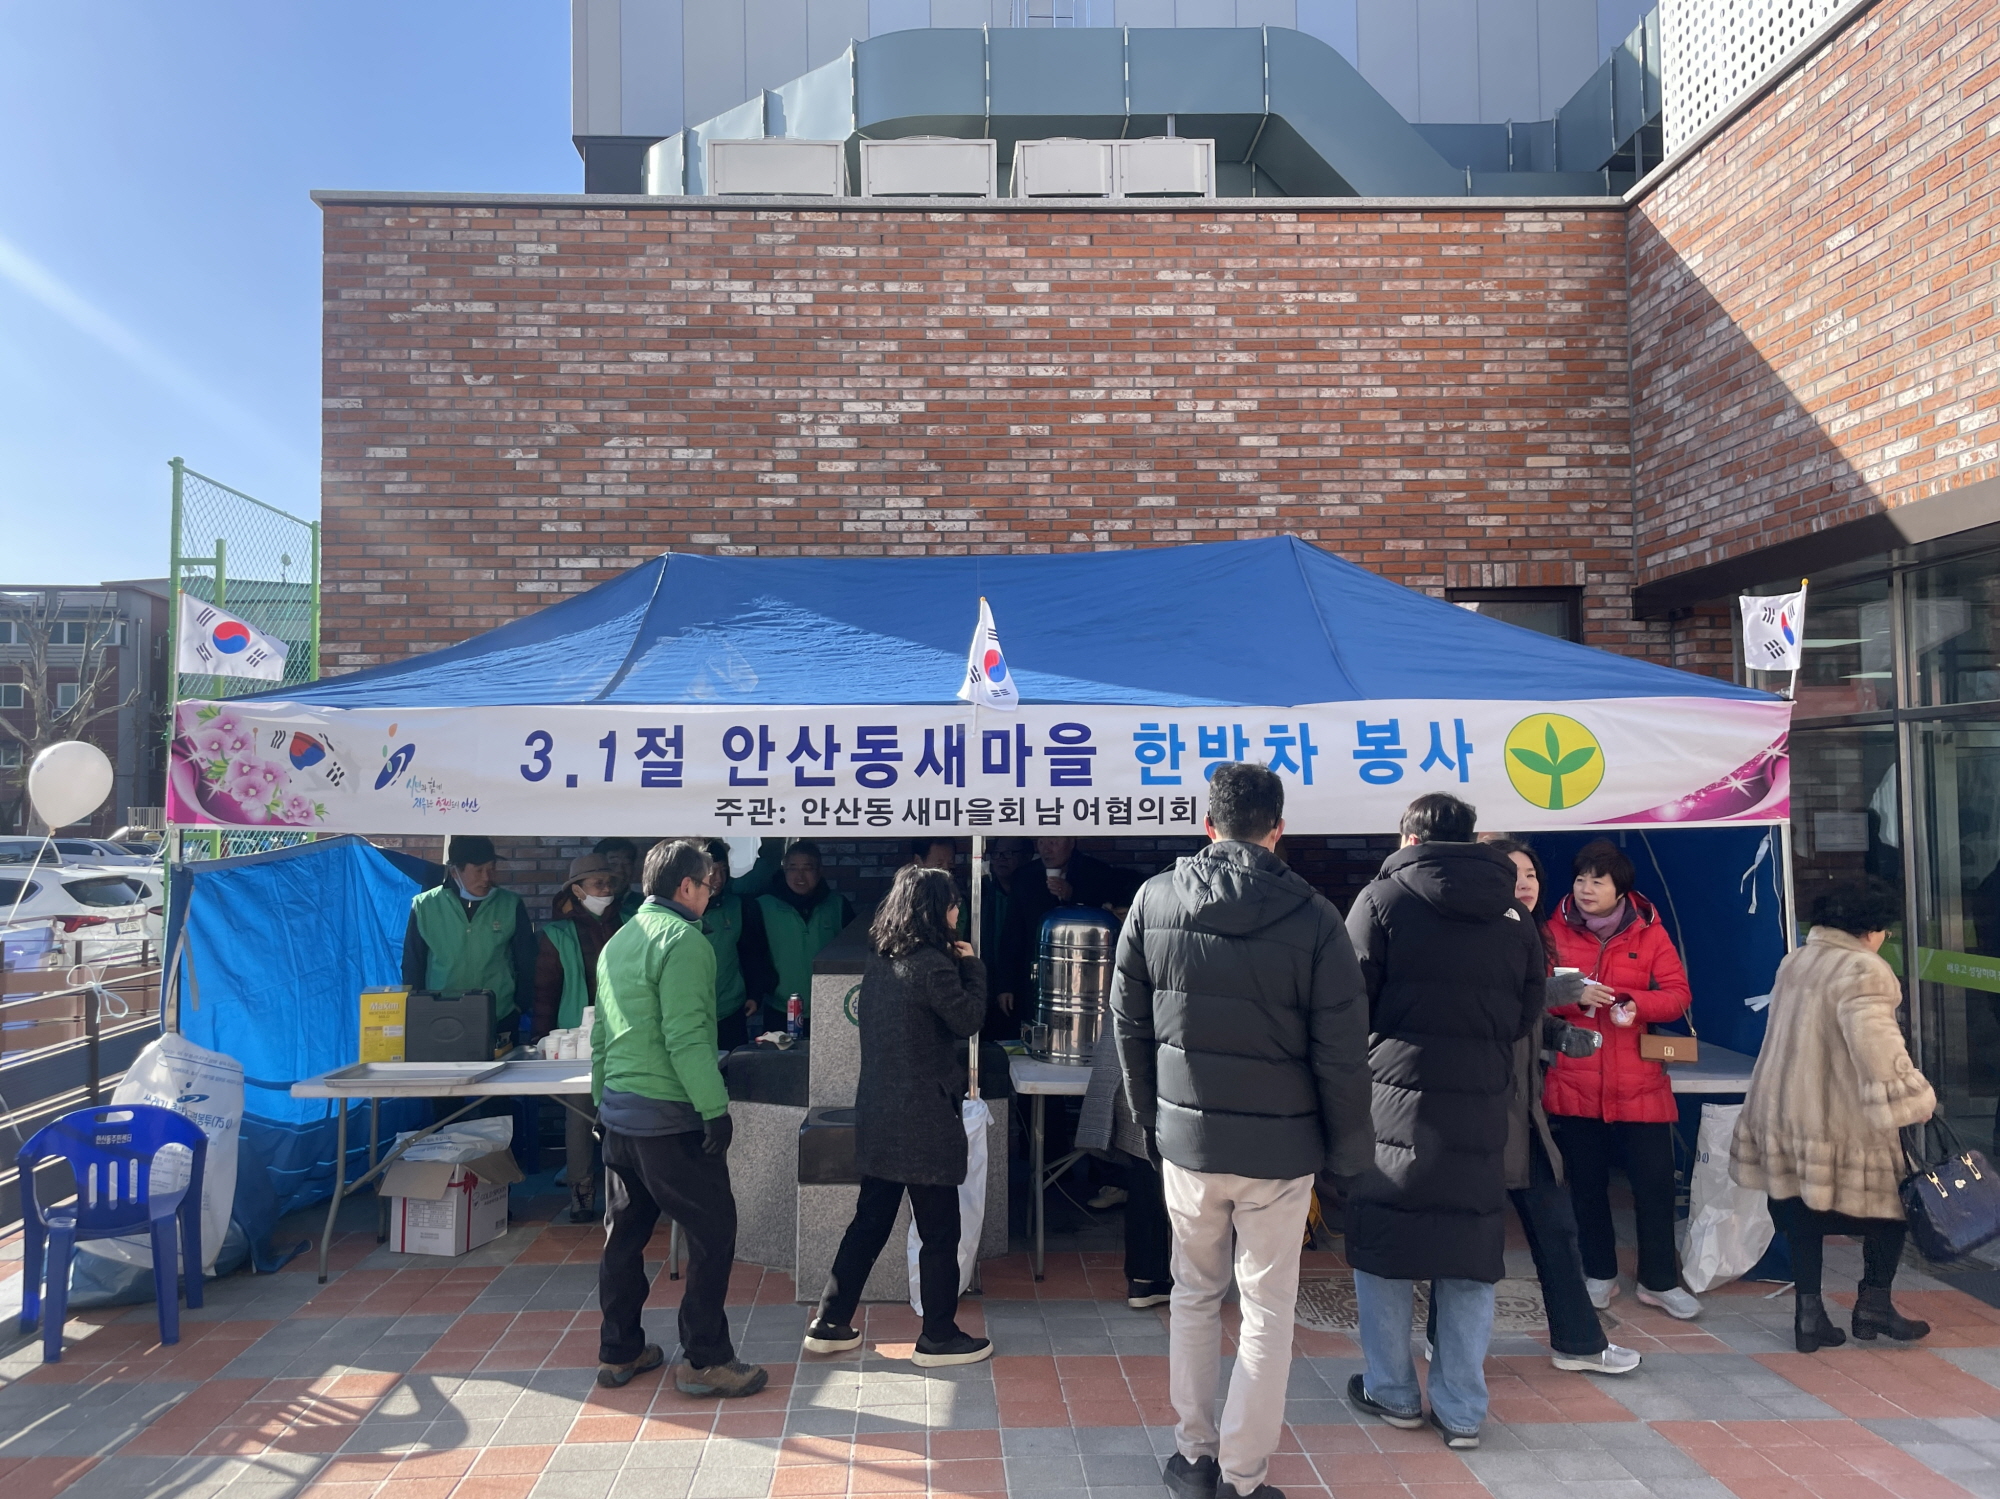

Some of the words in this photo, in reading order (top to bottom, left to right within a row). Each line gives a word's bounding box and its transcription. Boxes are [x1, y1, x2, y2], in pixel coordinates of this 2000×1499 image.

[520, 725, 684, 788] 3.1절
[1133, 722, 1319, 786] 한방차
[1352, 718, 1474, 785] 봉사
[461, 797, 480, 813] 안산
[714, 797, 786, 827] 주관:
[801, 797, 894, 827] 안산동
[901, 796, 1026, 827] 새마을회
[1946, 963, 1968, 975] 배우고
[1968, 966, 1997, 981] 성장하며
[369, 1002, 400, 1010] Maxim
